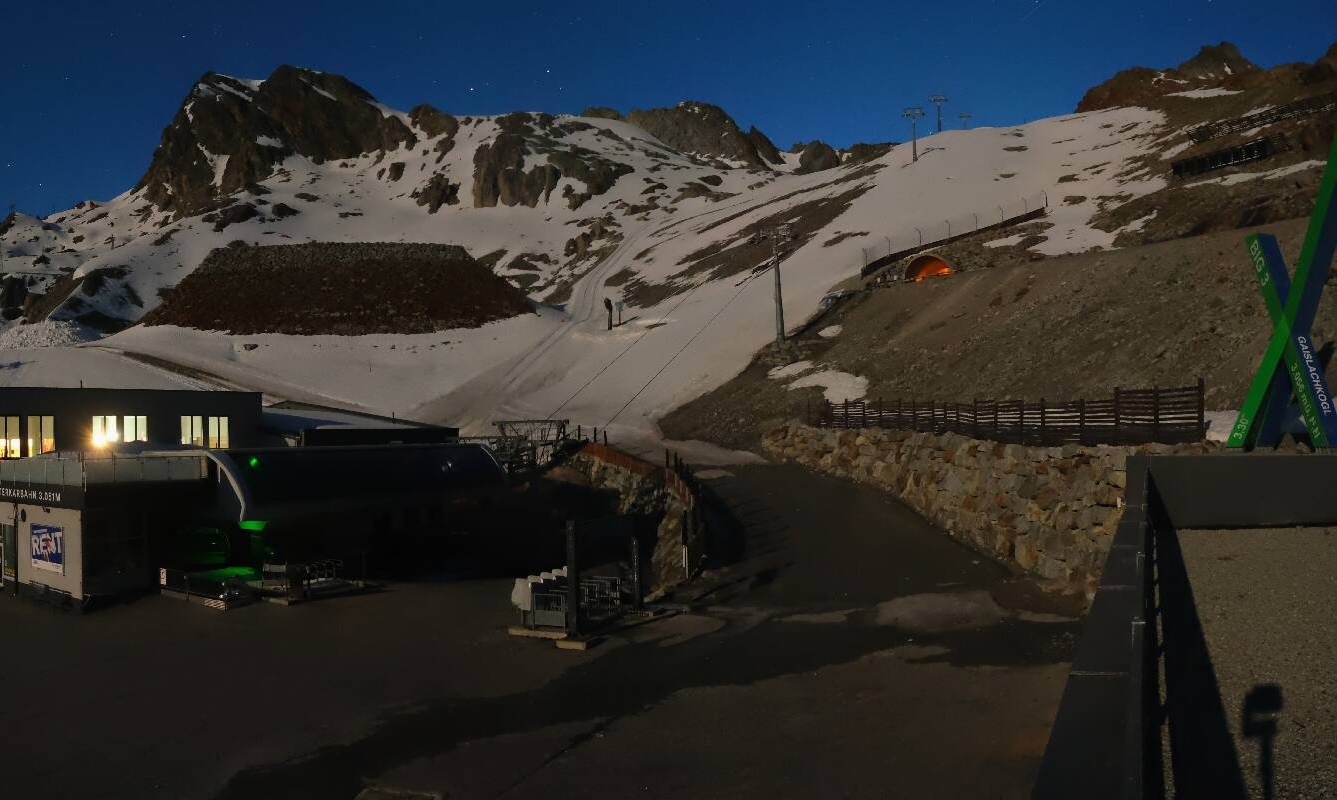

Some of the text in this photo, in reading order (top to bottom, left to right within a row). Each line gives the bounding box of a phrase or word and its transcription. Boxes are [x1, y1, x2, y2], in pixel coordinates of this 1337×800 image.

[1250, 239, 1270, 287] BIG 3
[1298, 336, 1332, 416] GAISLACHKOGL
[31, 531, 63, 558] RENT
